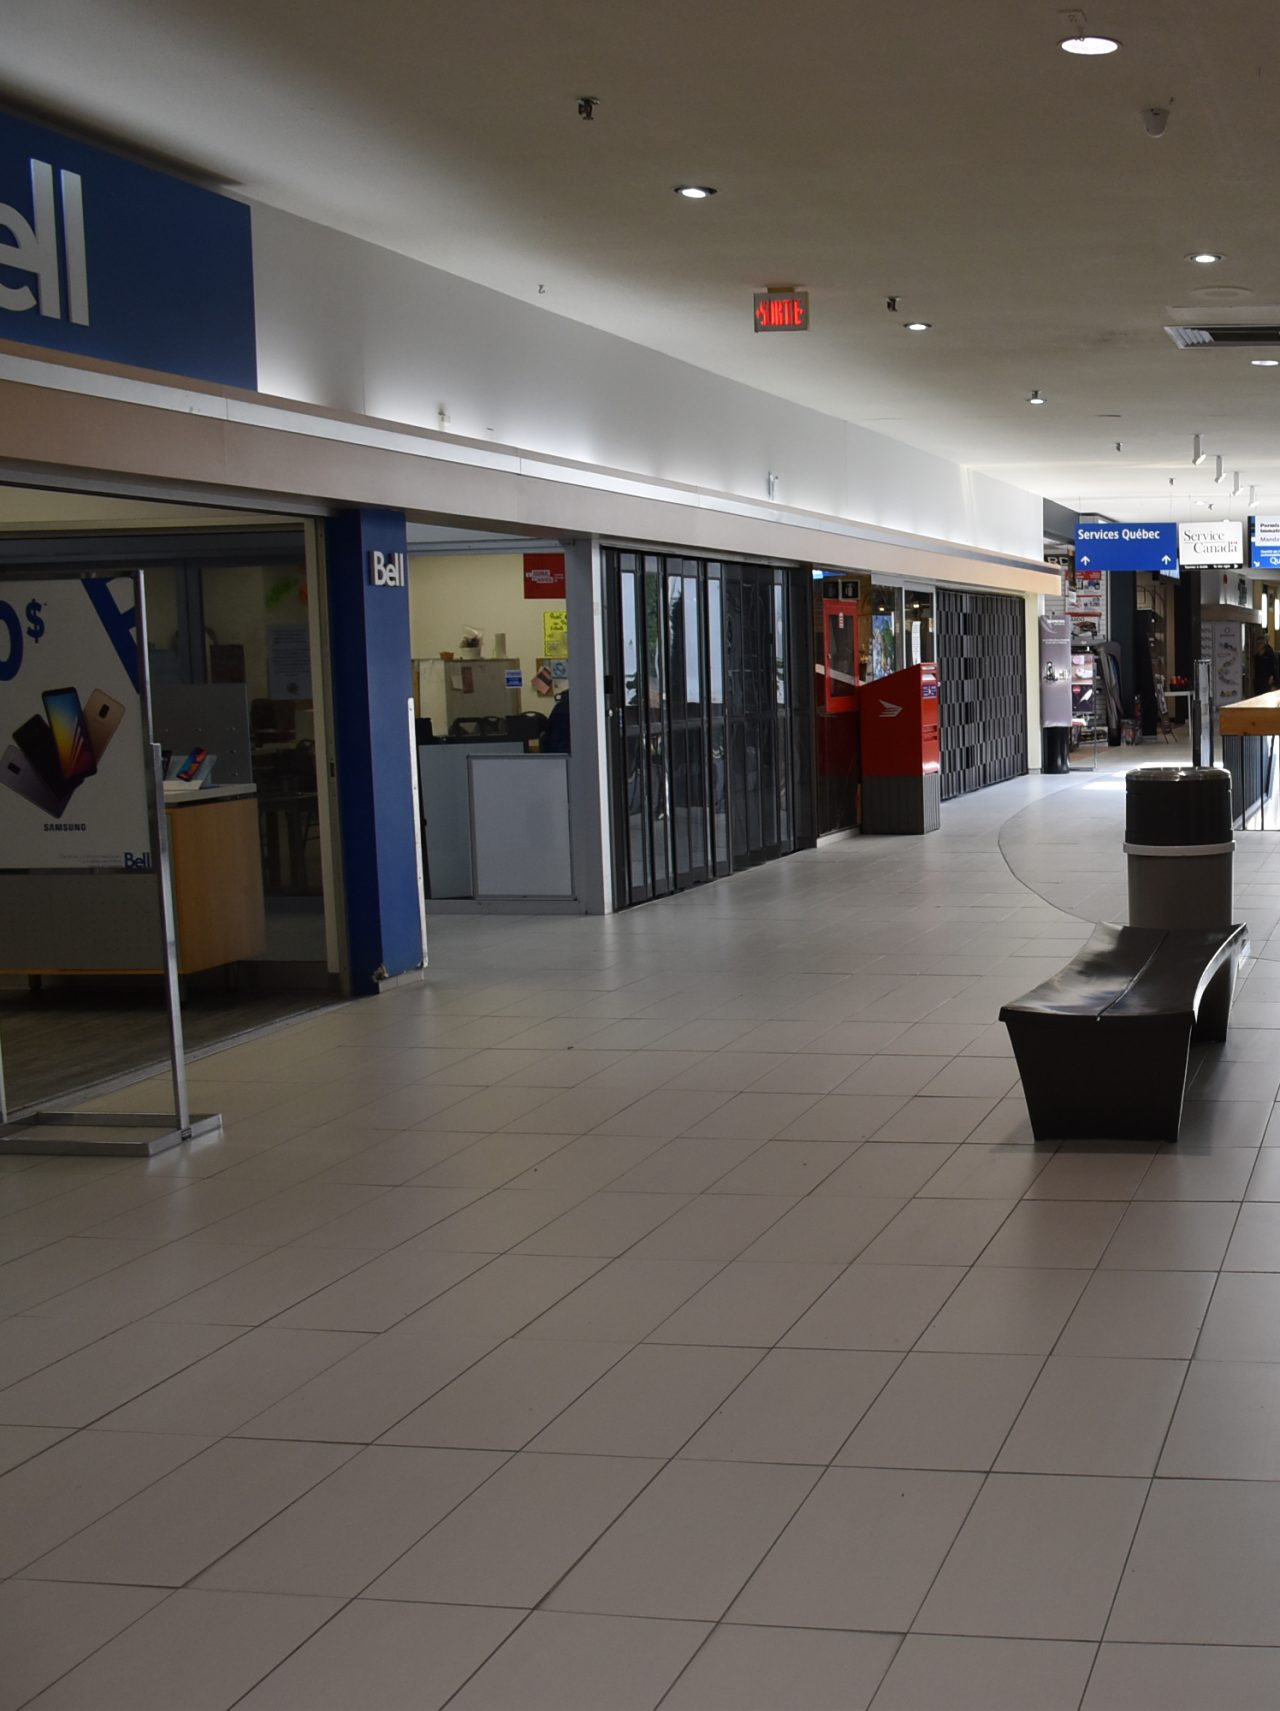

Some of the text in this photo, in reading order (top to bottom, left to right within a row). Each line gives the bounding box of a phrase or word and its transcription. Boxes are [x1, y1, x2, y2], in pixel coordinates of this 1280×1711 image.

[1078, 528, 1160, 541] Services Québec
[1184, 529, 1225, 541] Service
[1193, 541, 1238, 553] Canada
[373, 550, 405, 587] Bell
[43, 823, 87, 832] SAMSUNG
[124, 851, 150, 868] Bell
